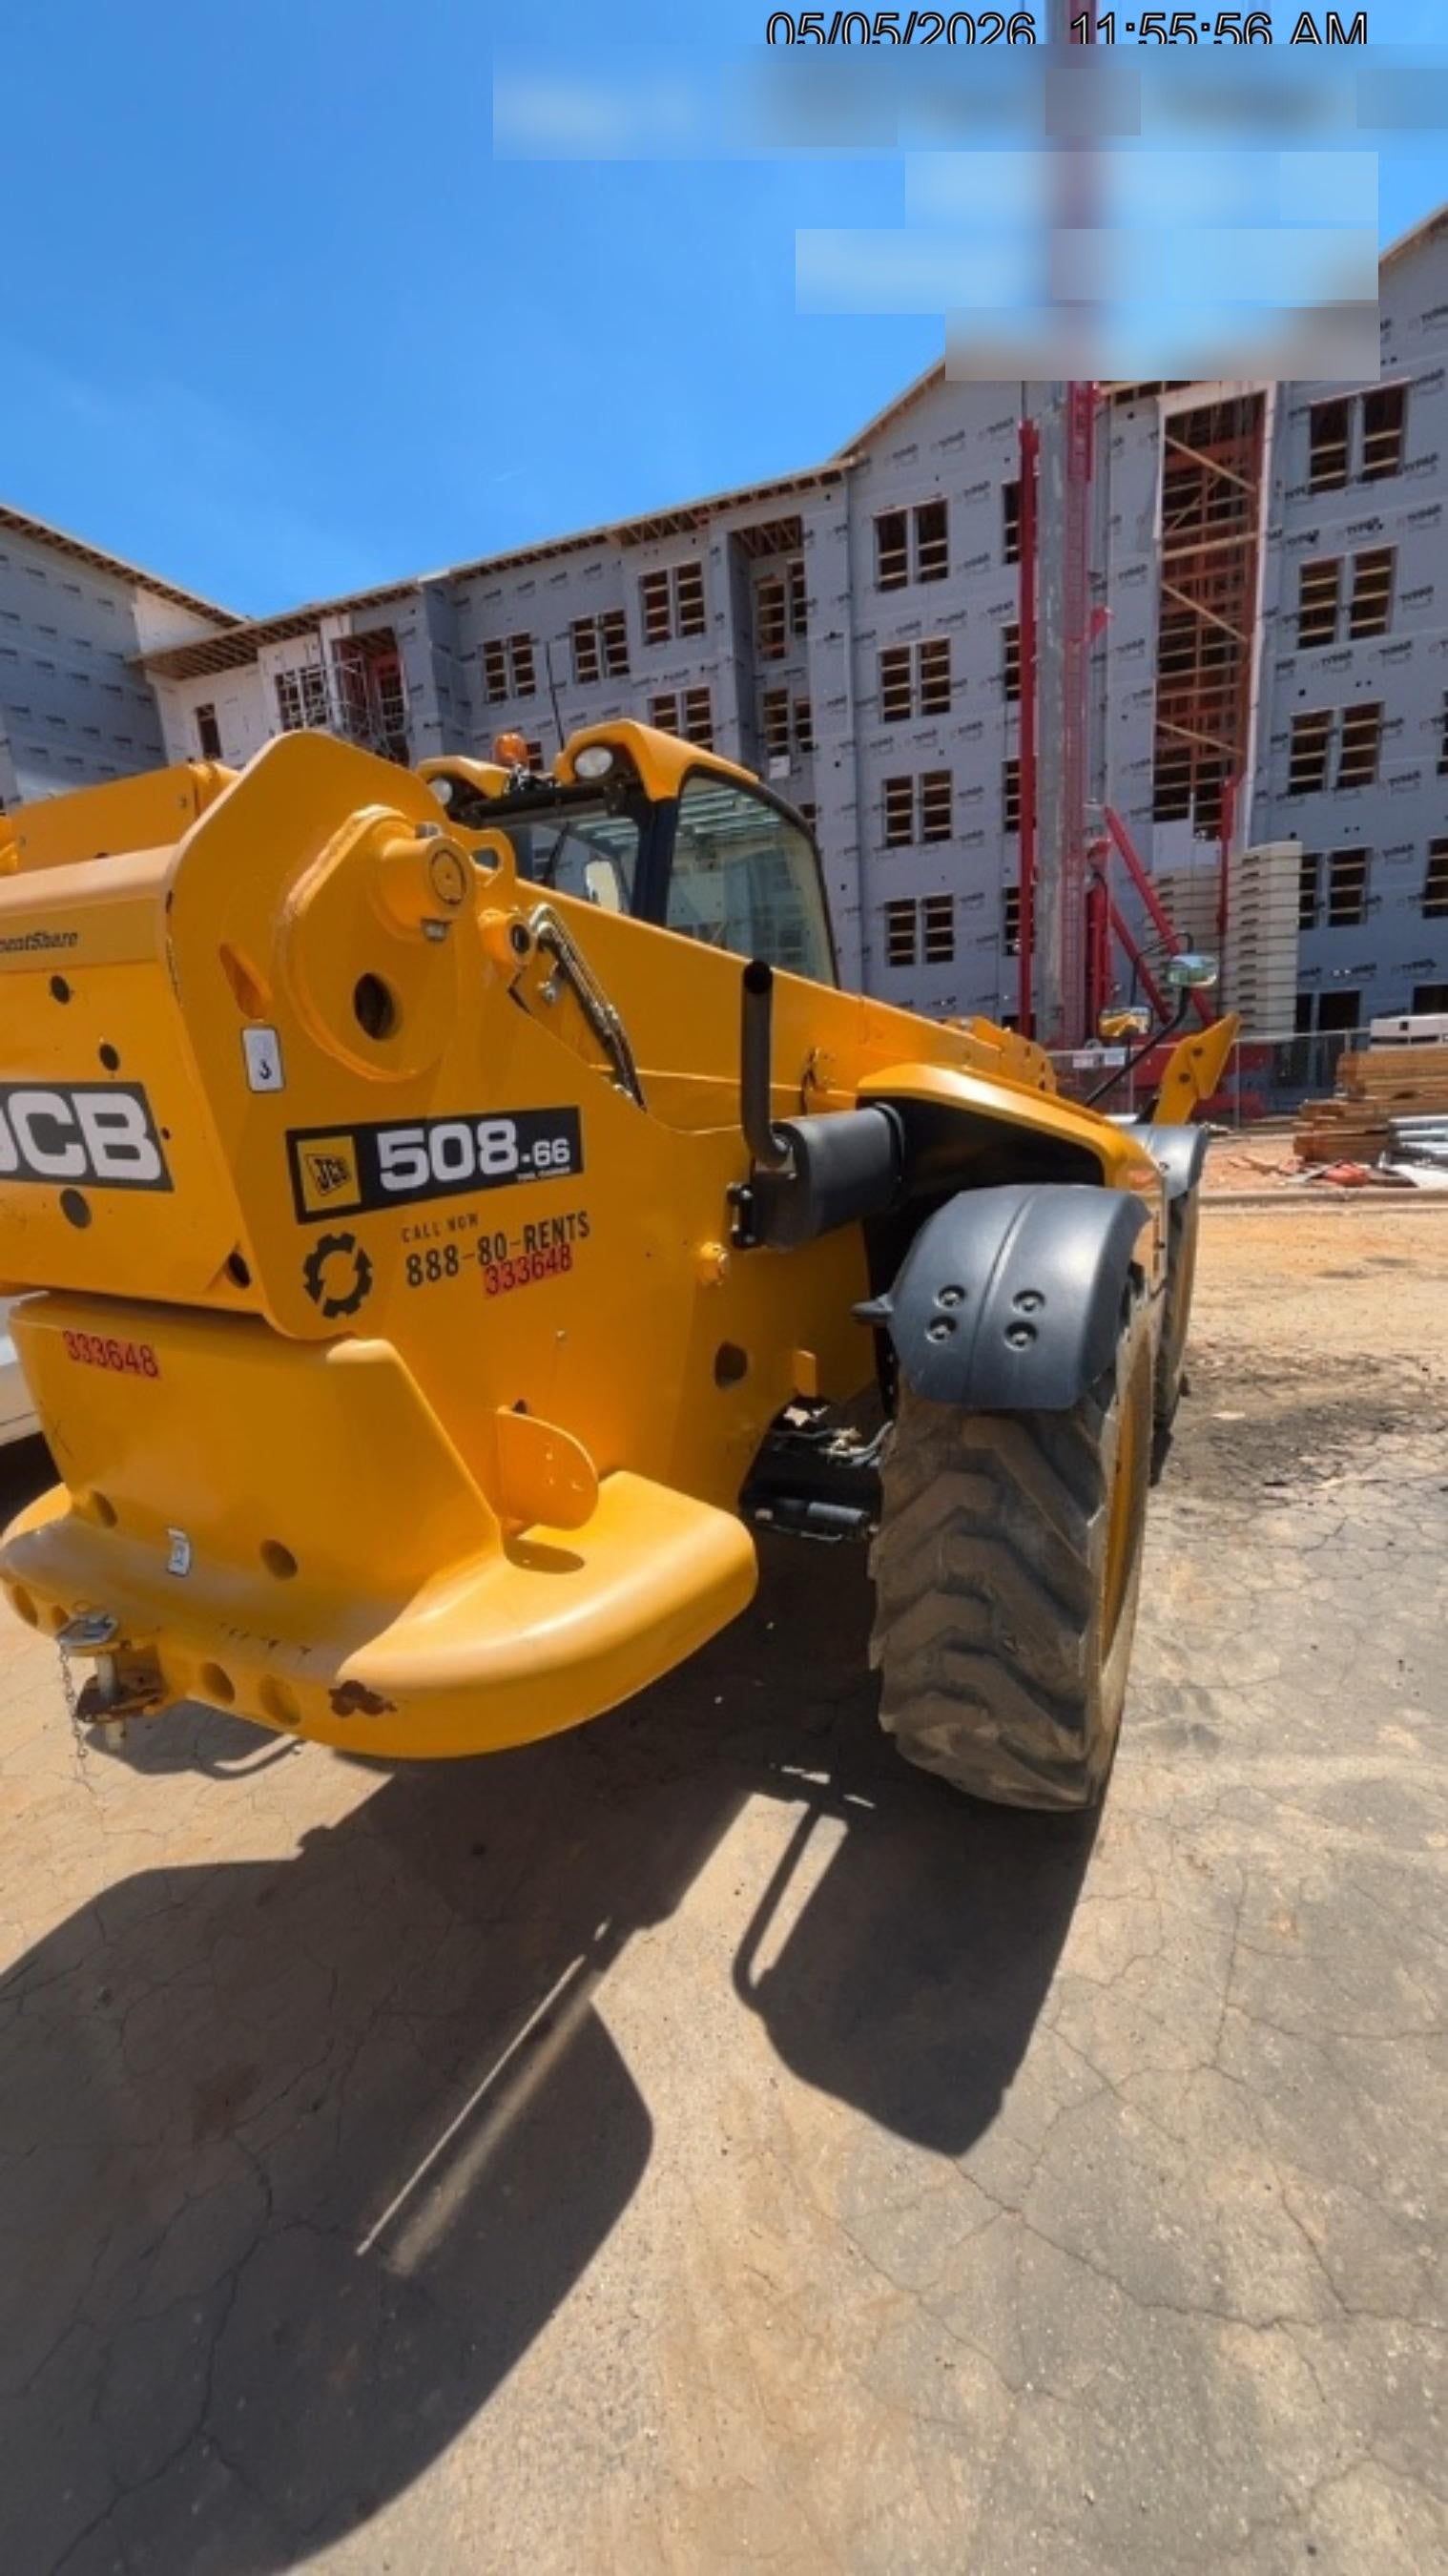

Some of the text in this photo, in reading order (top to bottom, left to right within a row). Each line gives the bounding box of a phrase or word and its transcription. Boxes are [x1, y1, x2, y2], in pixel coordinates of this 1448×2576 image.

[402, 1213, 479, 1242] CALL NOW
[405, 1210, 590, 1288] 888-80-RENTS
[485, 1243, 572, 1296] 333648
[62, 1330, 158, 1378] 333648
